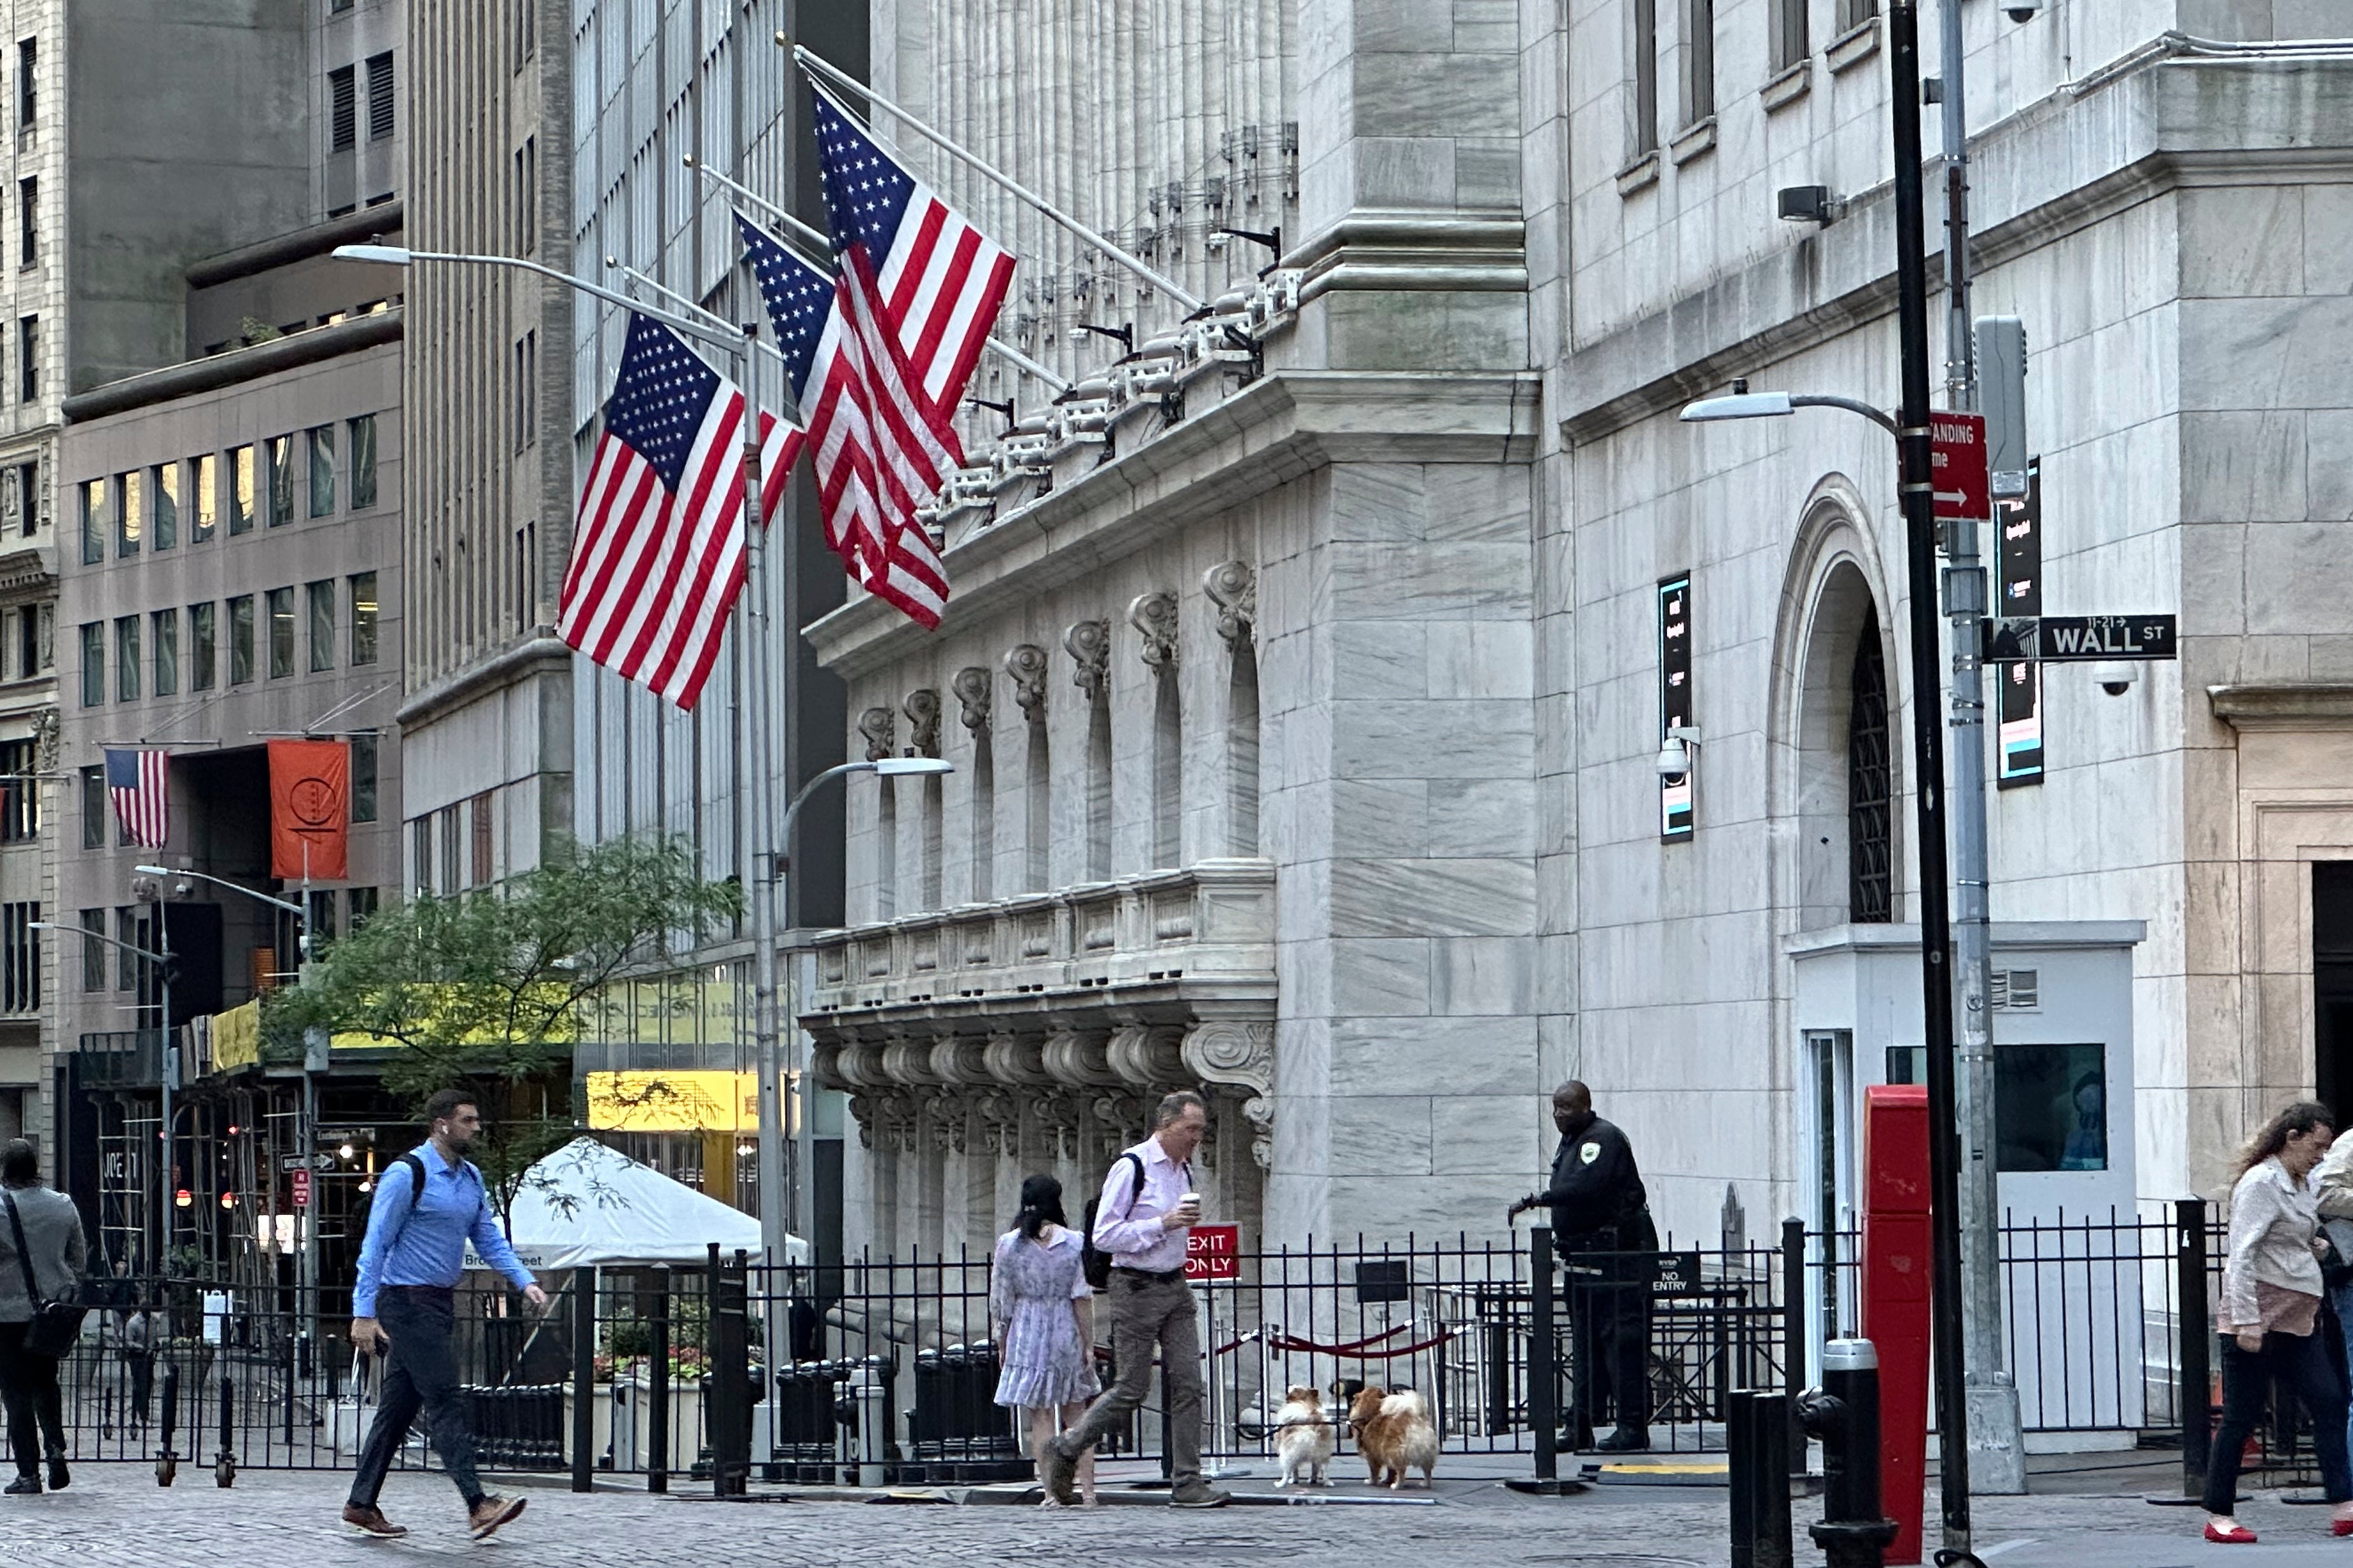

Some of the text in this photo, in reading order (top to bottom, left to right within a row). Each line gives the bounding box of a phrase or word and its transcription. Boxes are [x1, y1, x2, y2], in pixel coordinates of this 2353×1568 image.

[1932, 422, 1974, 444] ANDING
[2088, 616, 2114, 628] 11-21
[2053, 626, 2165, 653] WALL ST
[1187, 1235, 1225, 1251] EXIT
[1185, 1258, 1231, 1272] ONLY
[1662, 1272, 1679, 1280] NO
[1652, 1280, 1687, 1291] ENTRY
